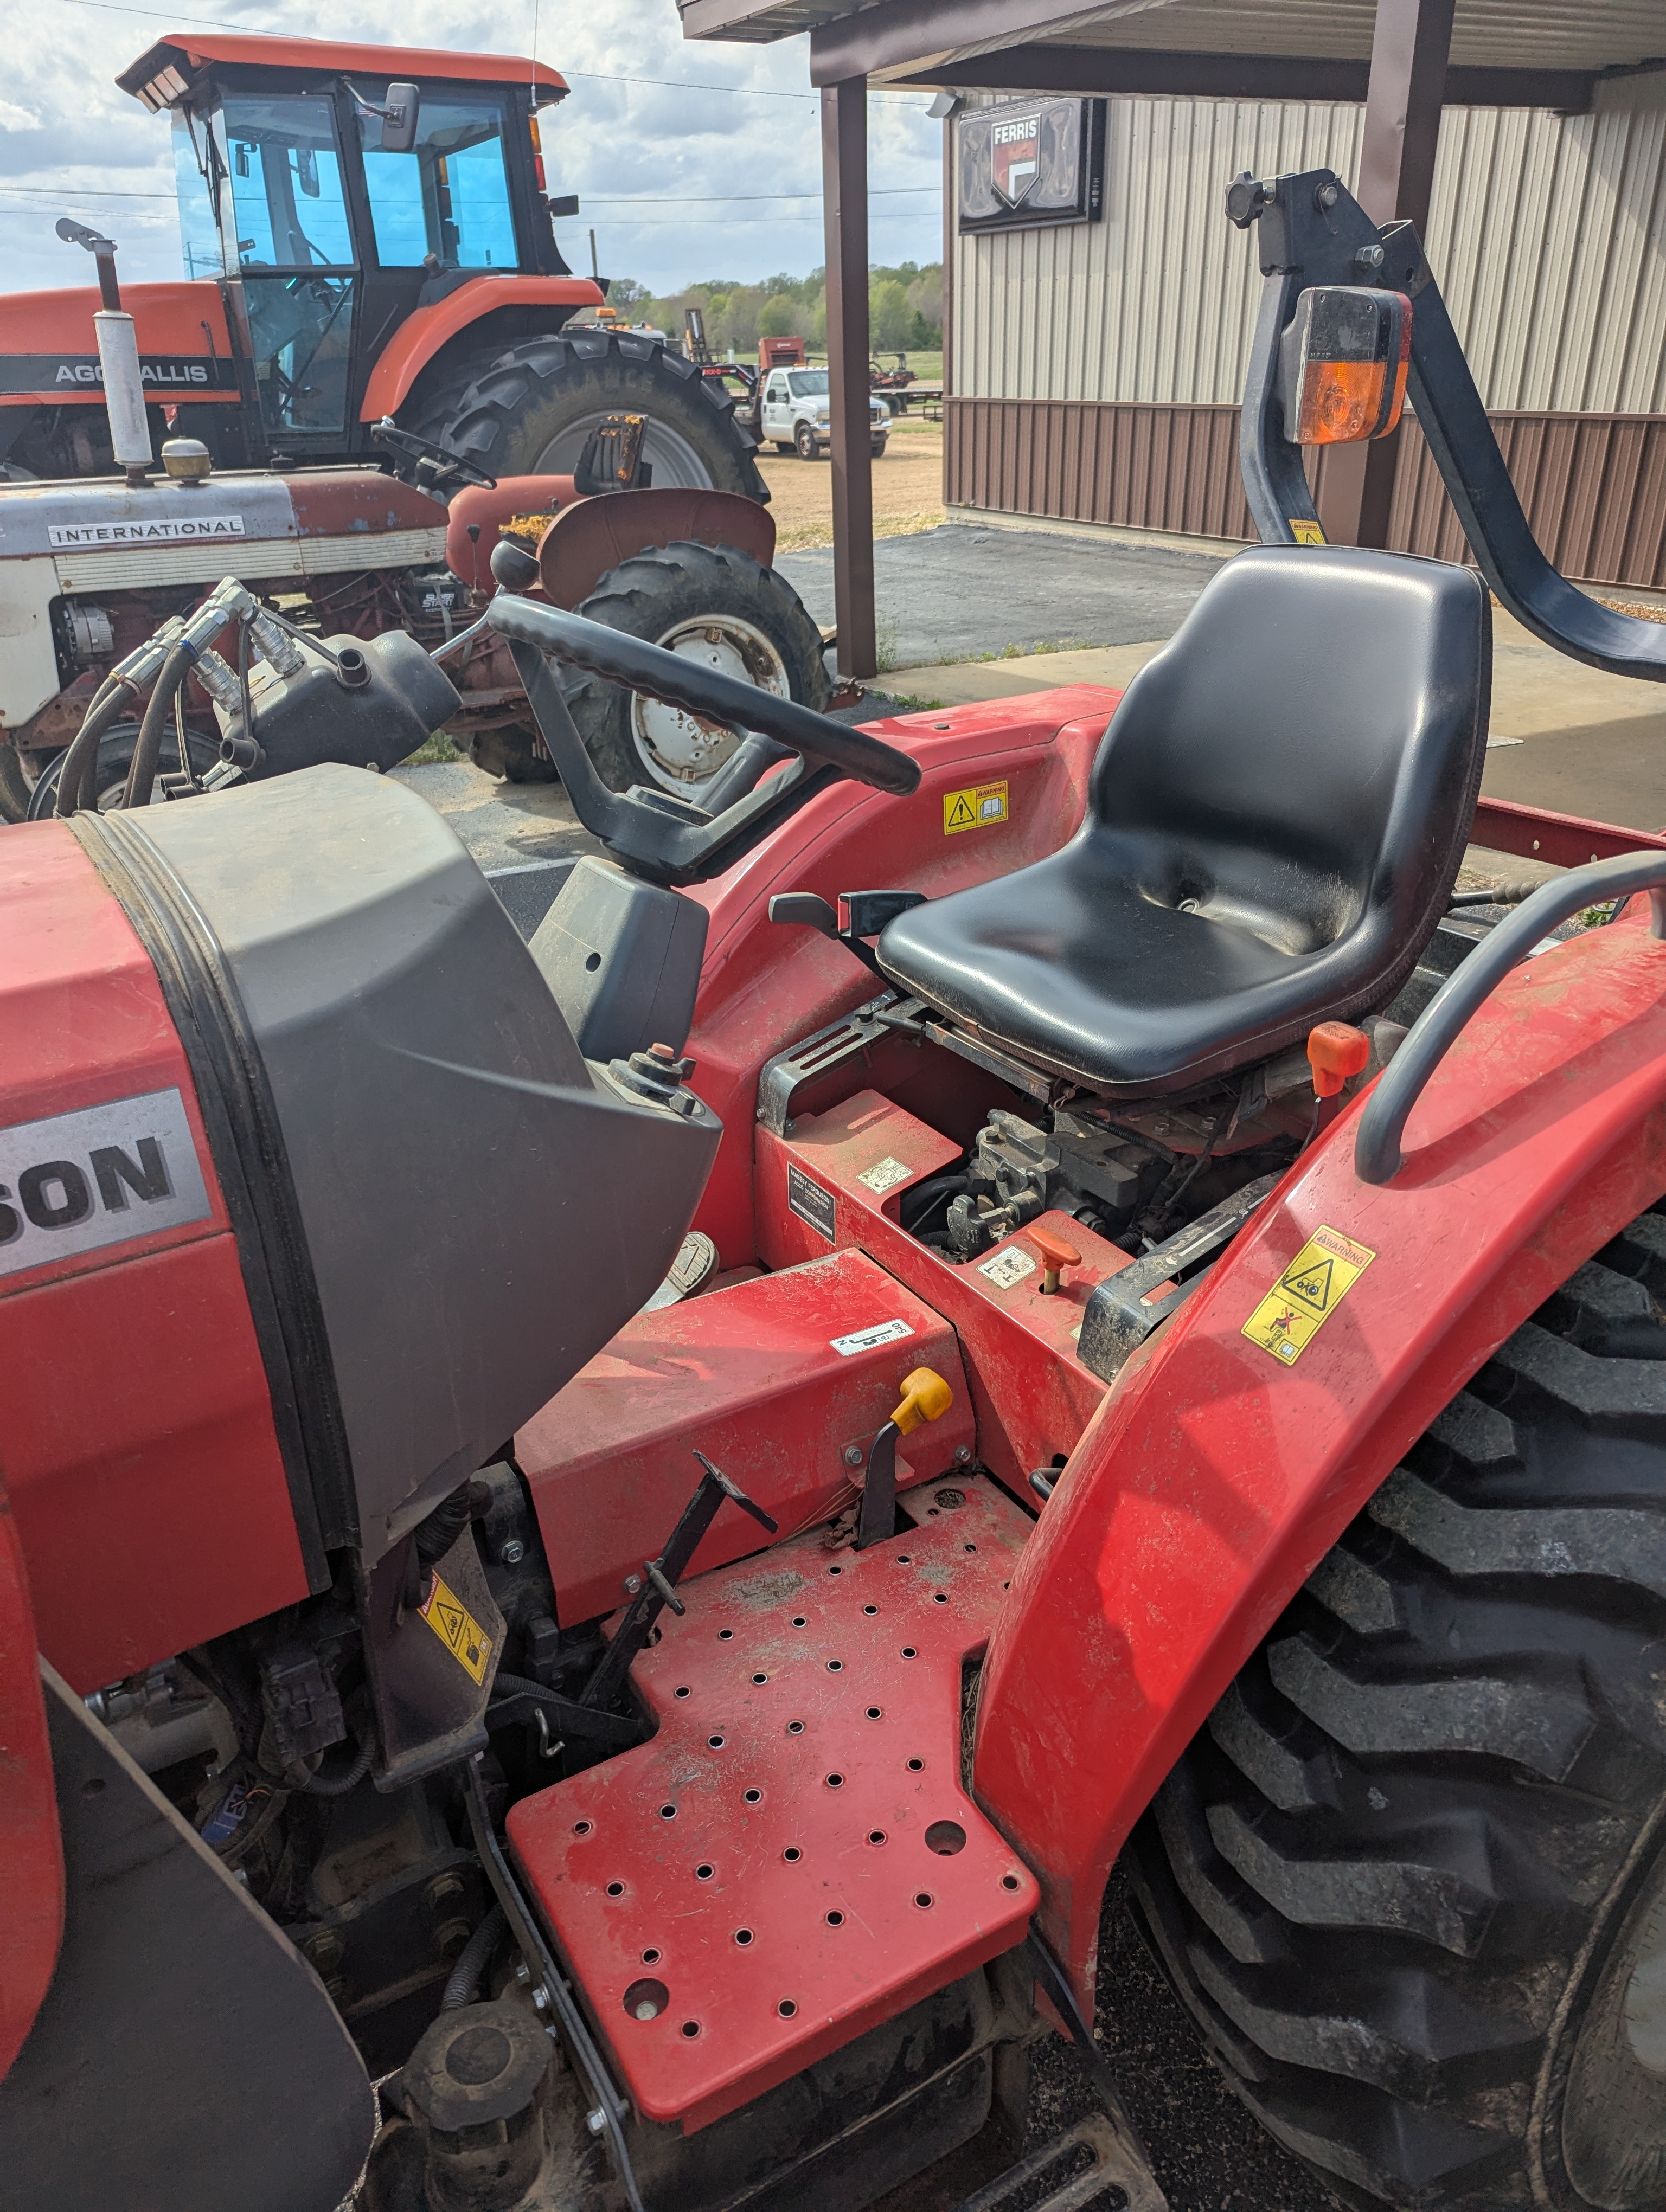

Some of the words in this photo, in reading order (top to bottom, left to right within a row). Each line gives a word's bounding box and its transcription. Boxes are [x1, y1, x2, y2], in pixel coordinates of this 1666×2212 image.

[994, 120, 1037, 145] FERRIS
[55, 366, 102, 382] AG
[141, 366, 208, 382] ALLIS
[57, 520, 241, 542] INTERNATIONAL
[982, 786, 1005, 795] WARNING
[791, 1169, 808, 1187] MASSEY
[808, 1182, 830, 1204] FERGUSON
[794, 1180, 804, 1191] AGCO
[804, 1188, 828, 1210] CORPORATION
[1326, 1239, 1365, 1265] WARNING
[892, 1323, 907, 1334] 540
